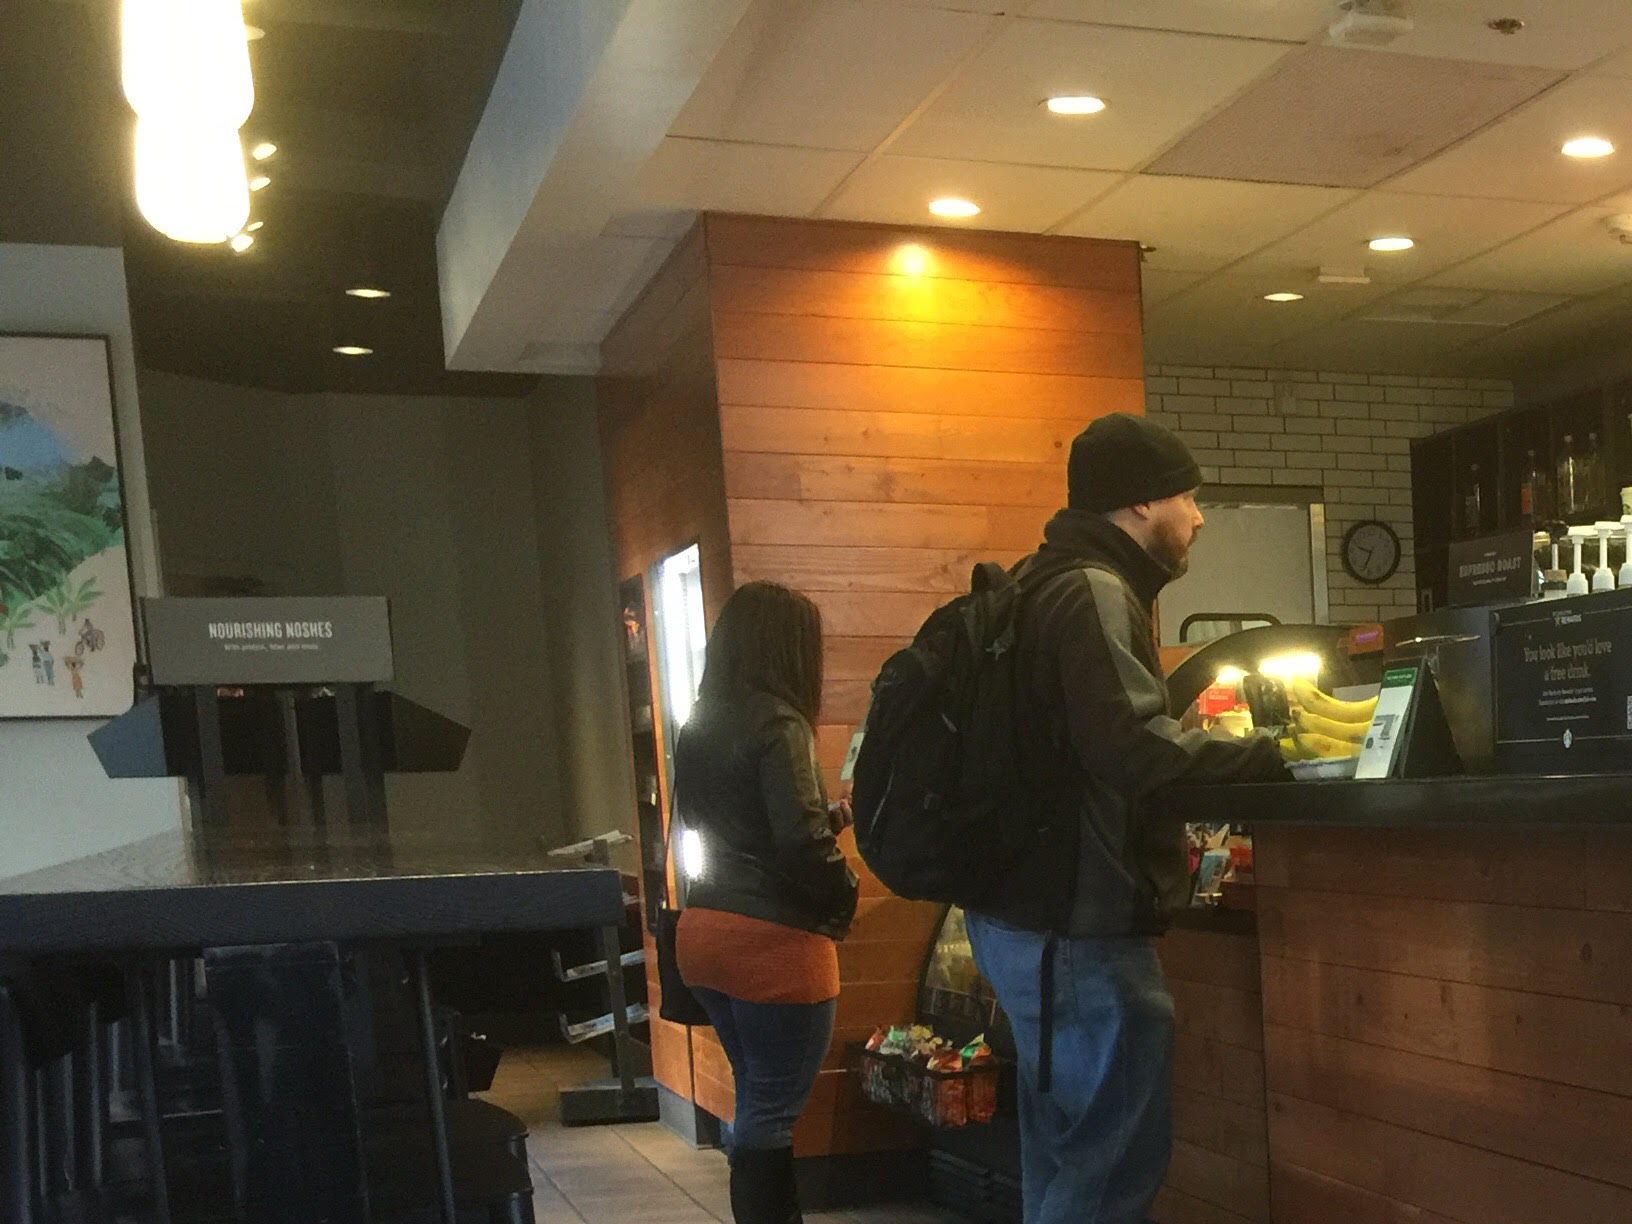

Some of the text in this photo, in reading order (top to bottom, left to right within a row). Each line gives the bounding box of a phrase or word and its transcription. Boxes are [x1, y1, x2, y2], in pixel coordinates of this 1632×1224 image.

[208, 620, 333, 640] NOURISHING NOSHES
[1523, 646, 1538, 662] You
[1539, 644, 1556, 661] look
[1557, 641, 1572, 659] like
[1594, 638, 1612, 655] love
[1550, 666, 1566, 681] free
